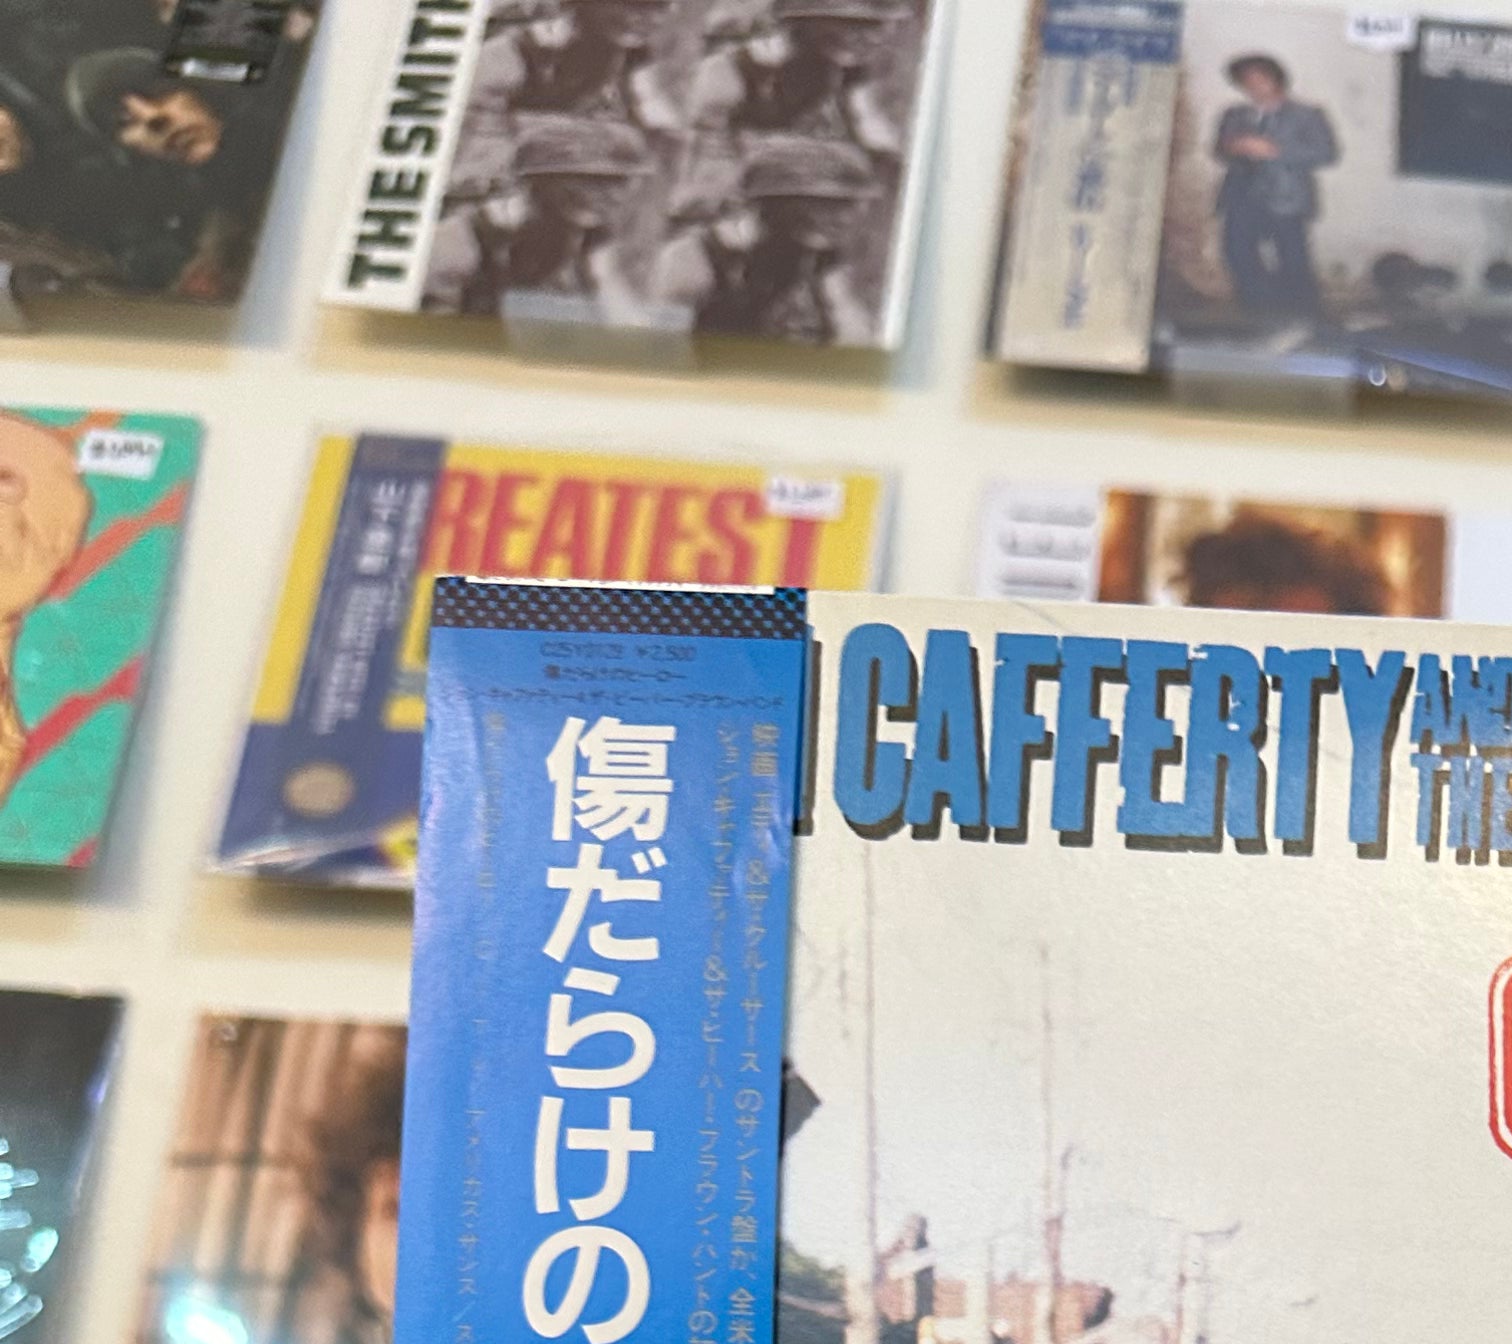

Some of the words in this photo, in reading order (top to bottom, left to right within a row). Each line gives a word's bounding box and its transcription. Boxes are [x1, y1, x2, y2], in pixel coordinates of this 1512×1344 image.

[378, 0, 471, 157] SMIT
[347, 168, 430, 288] THE
[832, 622, 1415, 860] CAFFERTY
